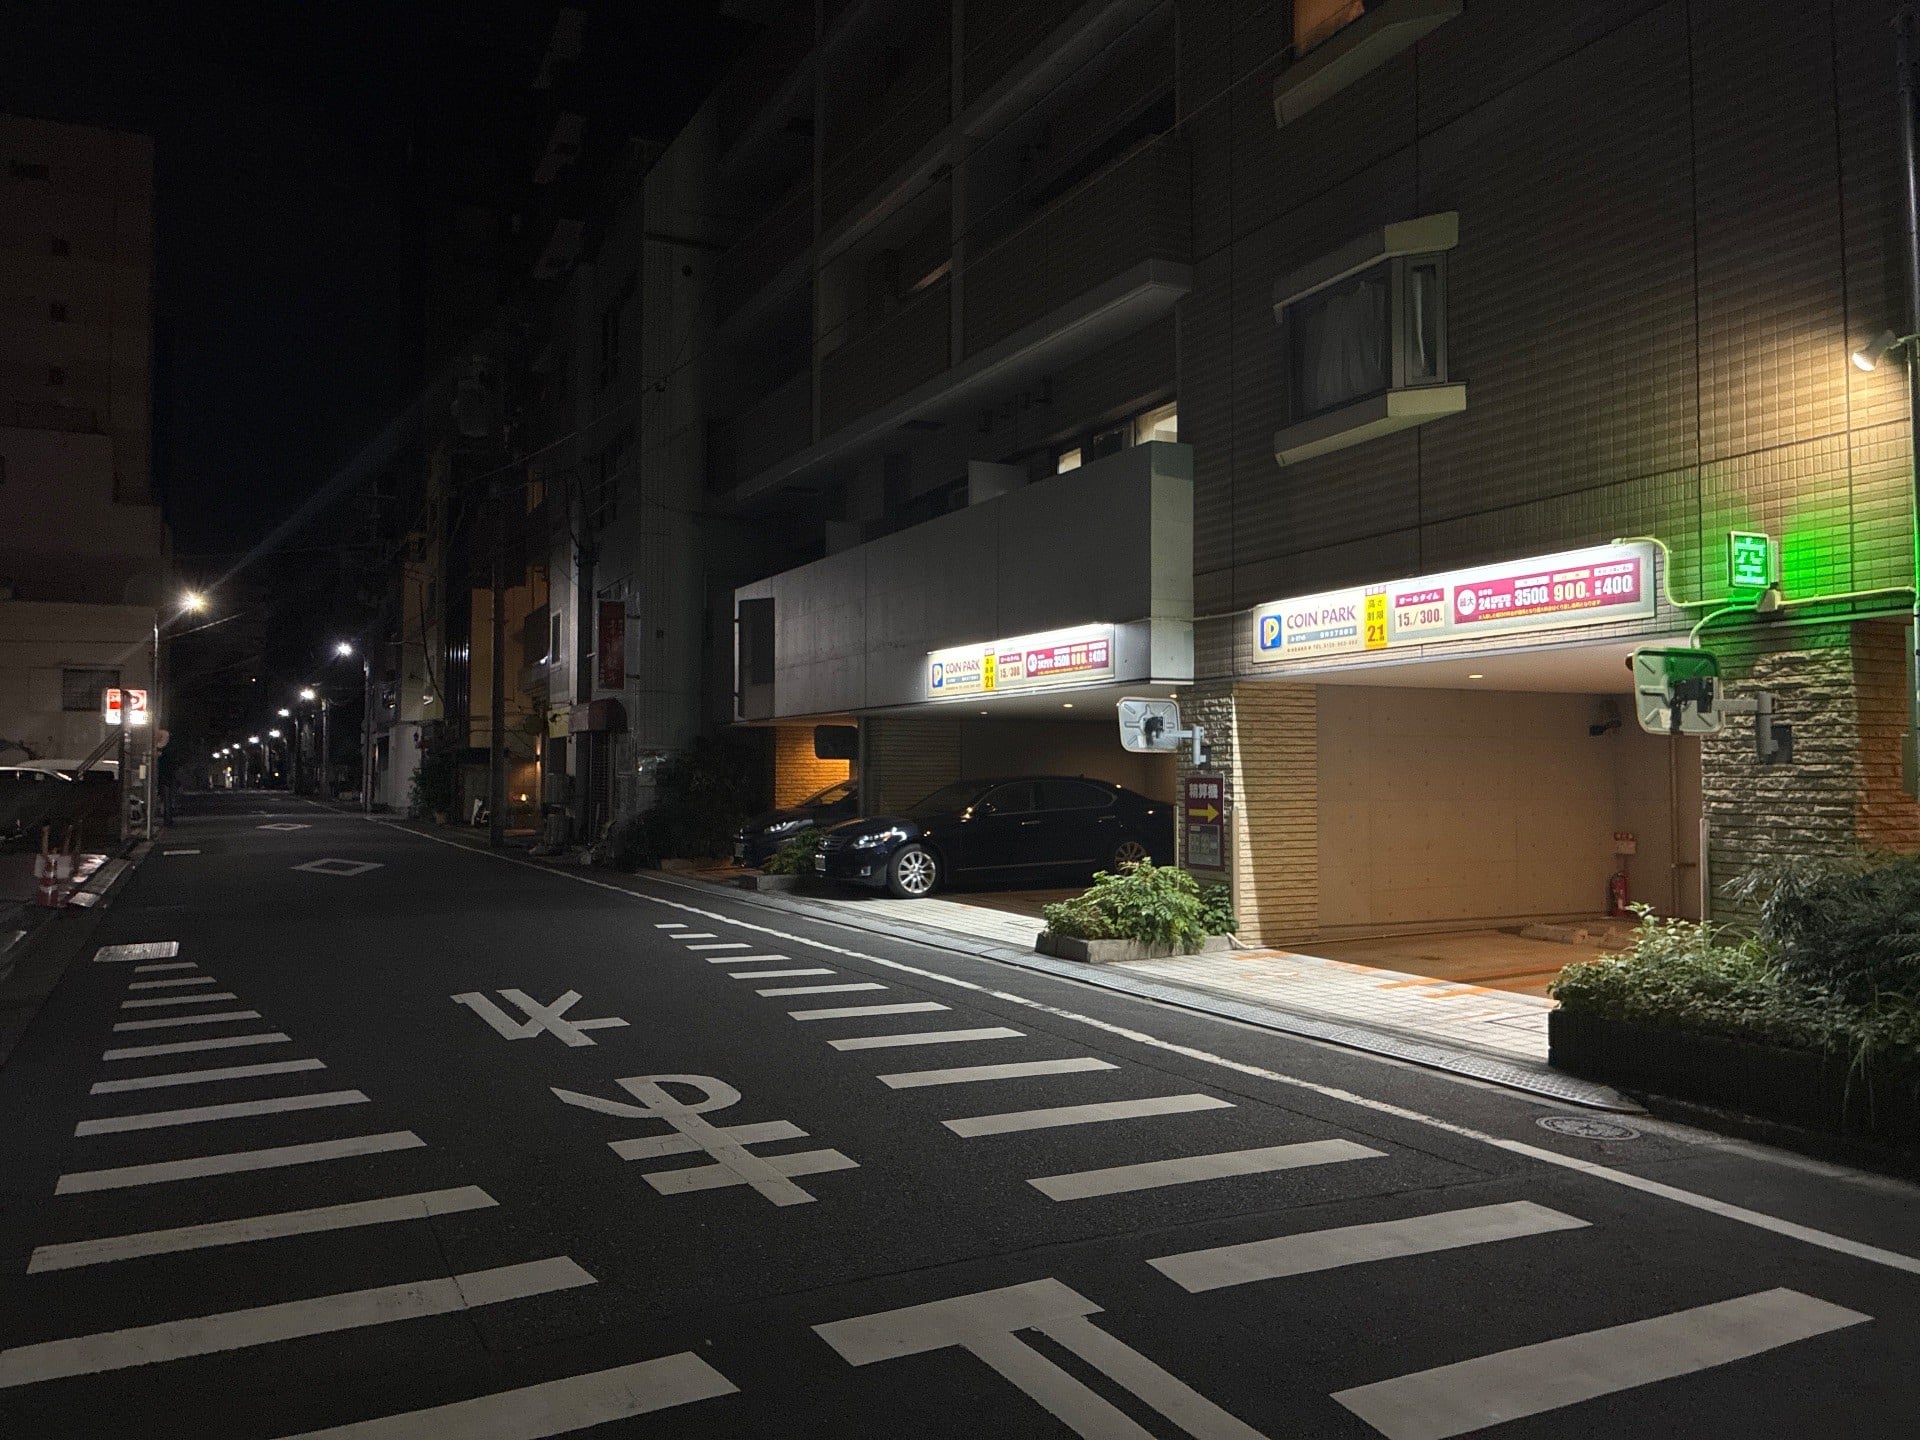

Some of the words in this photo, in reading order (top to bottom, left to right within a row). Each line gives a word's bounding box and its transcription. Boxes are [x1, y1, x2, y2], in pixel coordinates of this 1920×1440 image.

[1734, 537, 1768, 584] 空
[1287, 610, 1318, 630] COIN
[1321, 604, 1357, 625] PARK
[945, 663, 962, 674] COIN
[963, 659, 980, 673] PARK
